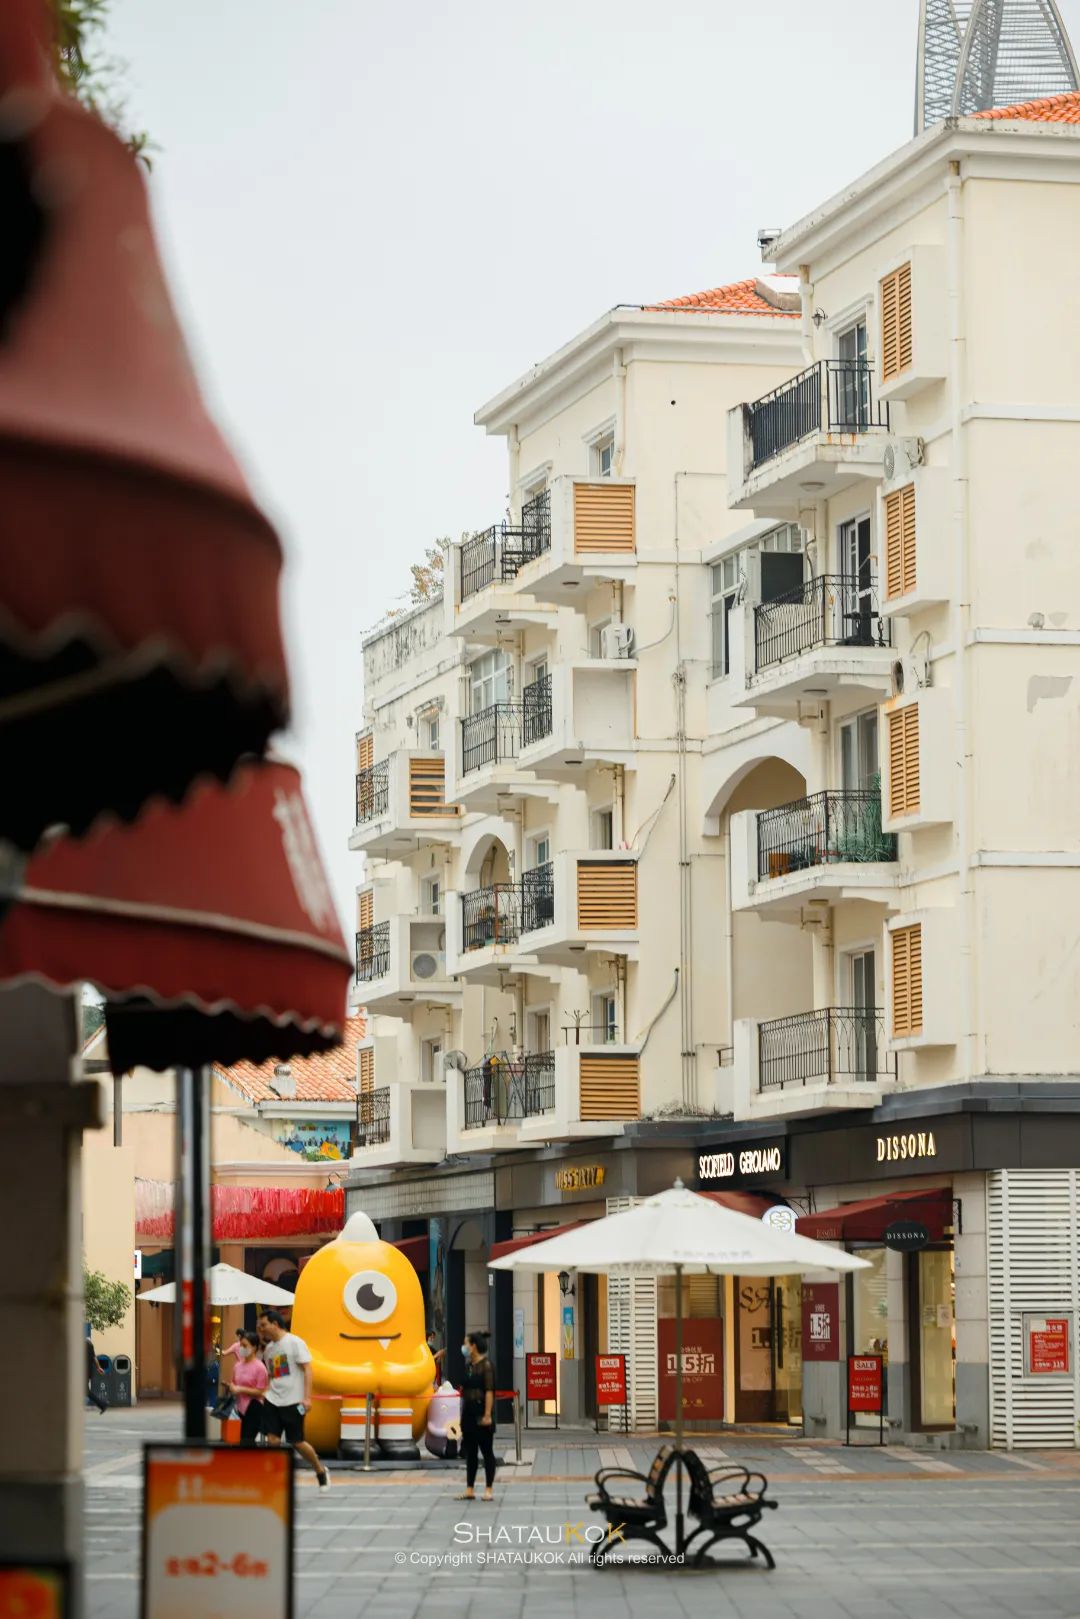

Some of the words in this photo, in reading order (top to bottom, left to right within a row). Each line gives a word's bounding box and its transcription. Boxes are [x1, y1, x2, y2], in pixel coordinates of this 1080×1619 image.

[877, 1132, 936, 1161] DISSONA
[699, 1152, 735, 1179] SCOFIELD
[740, 1147, 780, 1174] GEROLAMO
[886, 1232, 925, 1240] DISSONA
